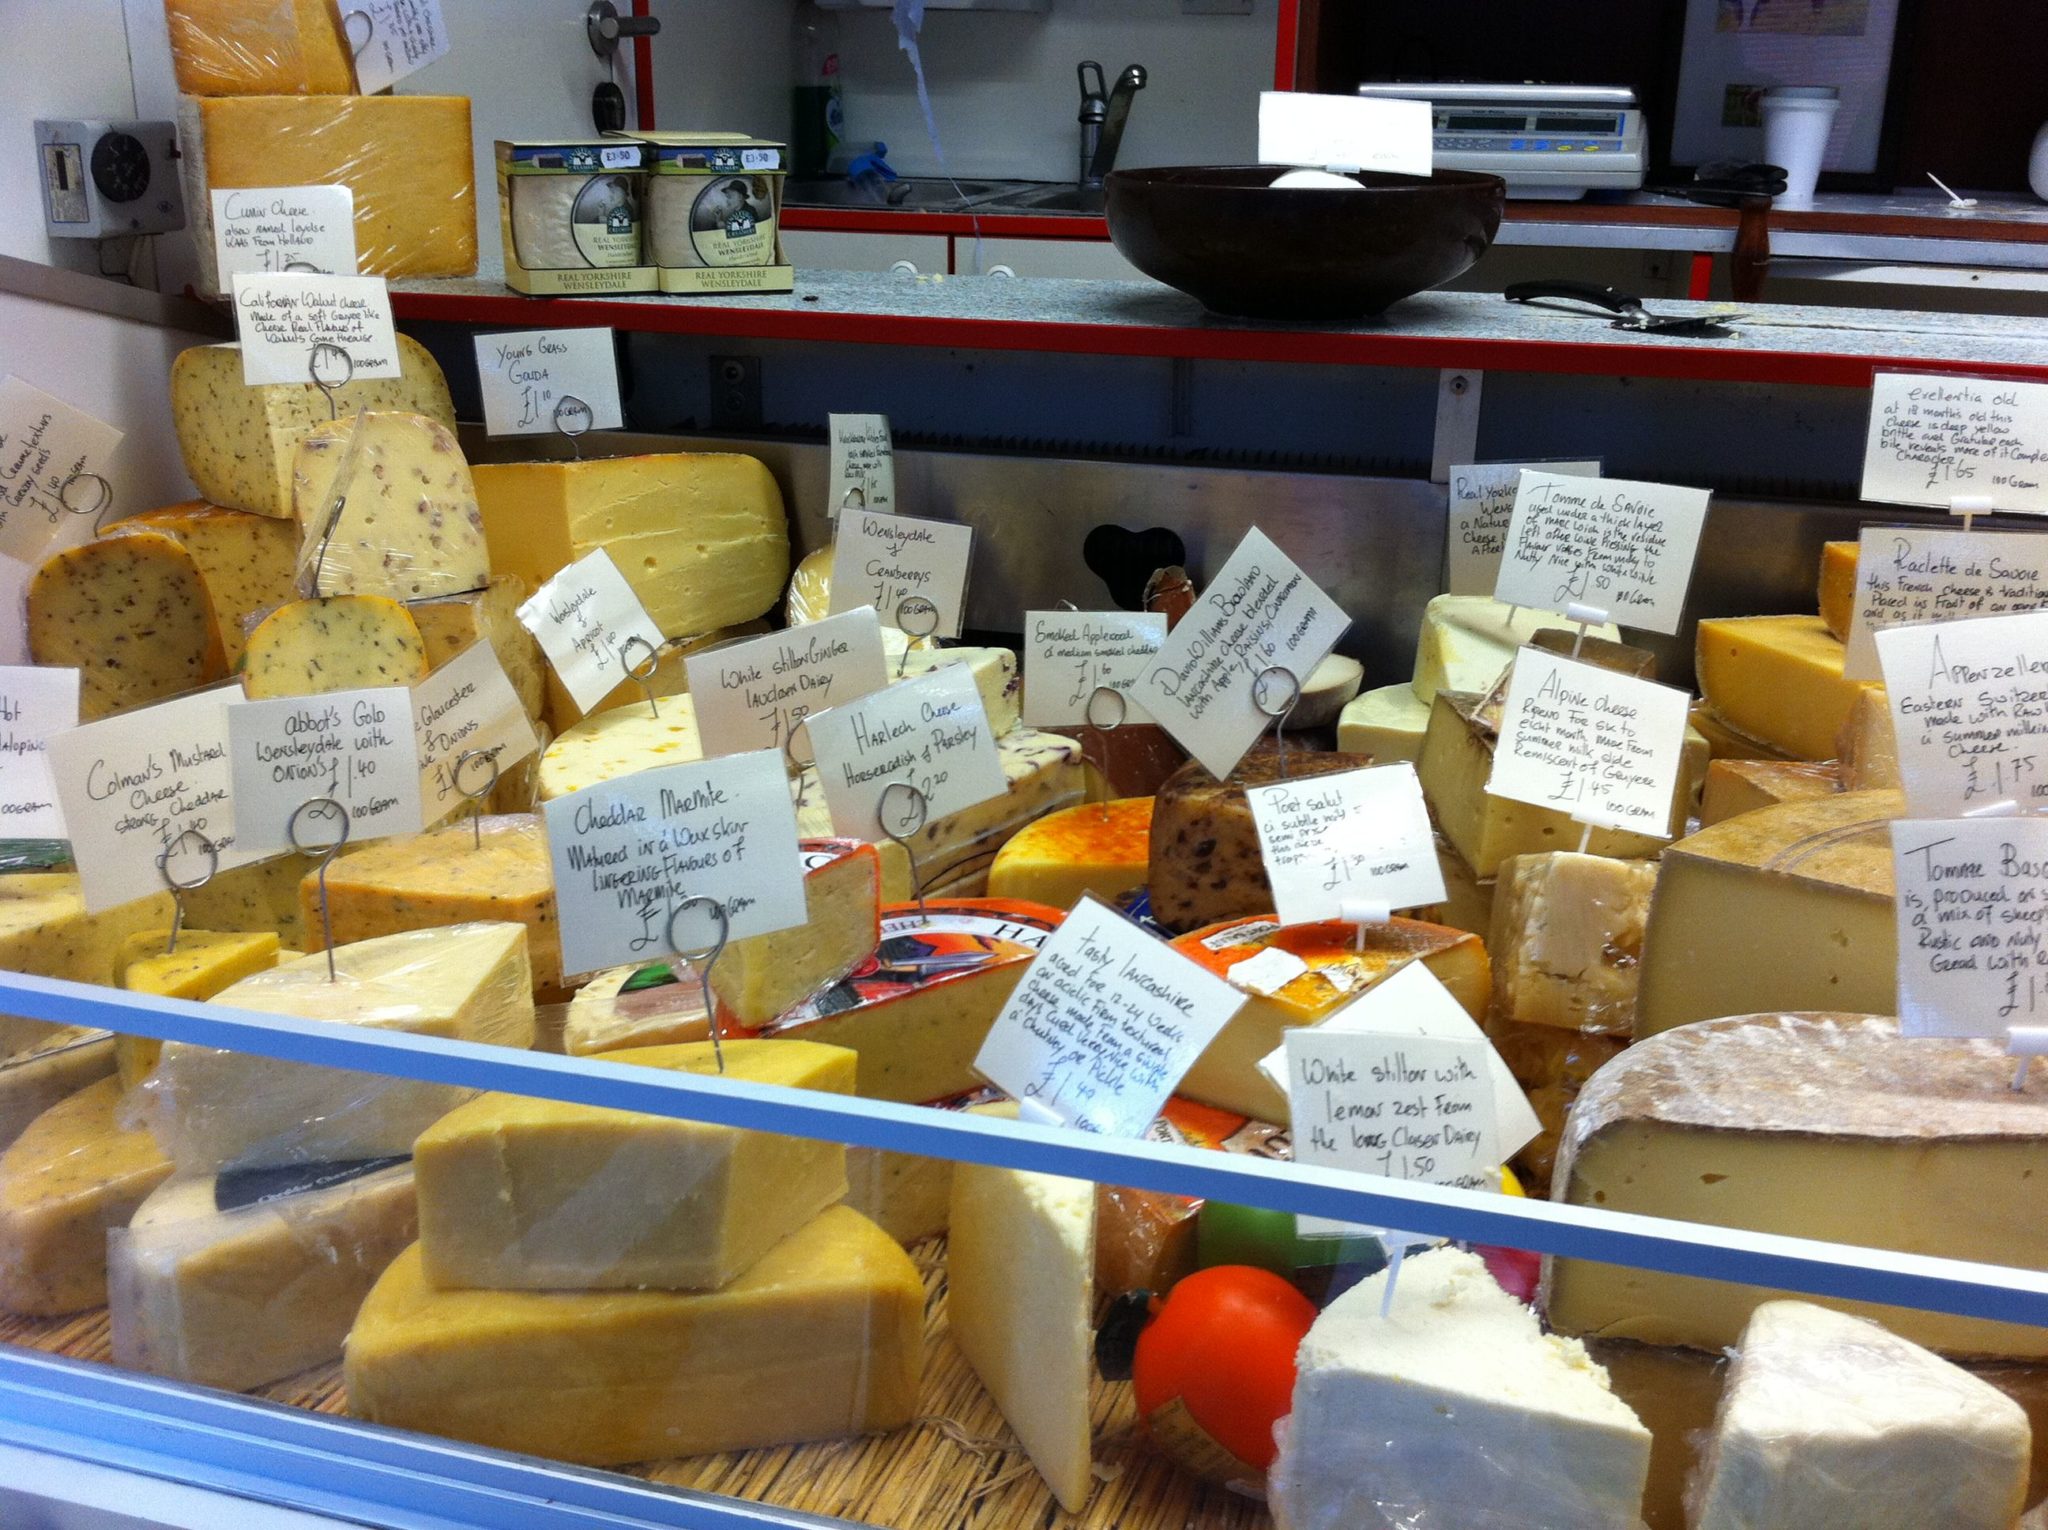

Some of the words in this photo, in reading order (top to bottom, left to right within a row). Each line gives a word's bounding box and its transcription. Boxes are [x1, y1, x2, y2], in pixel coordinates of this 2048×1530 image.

[557, 274, 579, 282] REAL
[581, 272, 631, 281] YORKSHIRE
[695, 272, 716, 280] REAL
[719, 270, 767, 279] YORKSHIRE
[563, 280, 627, 290] WENSLEYDALE
[701, 279, 762, 288] WENSLEYDALE
